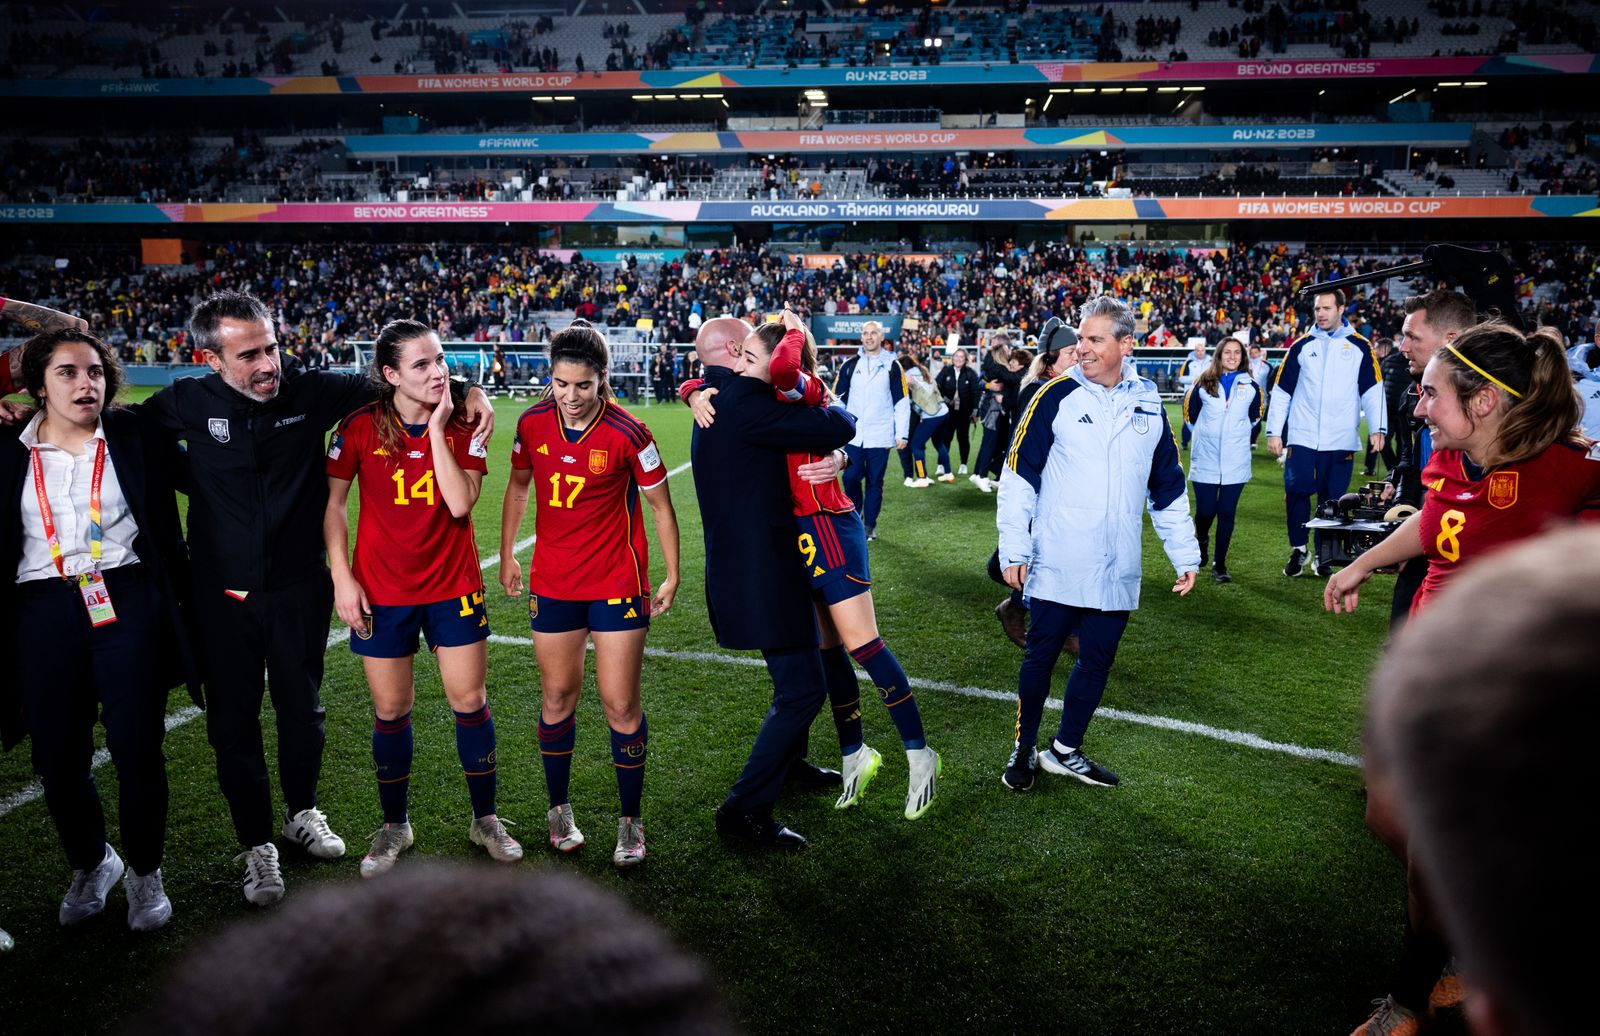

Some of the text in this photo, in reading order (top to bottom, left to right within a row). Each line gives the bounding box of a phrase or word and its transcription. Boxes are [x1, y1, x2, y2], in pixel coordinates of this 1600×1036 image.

[1237, 63, 1292, 75] BEYOND
[417, 76, 573, 88] FIFA WOMEN'S WORLD CUP
[479, 138, 539, 148] #FIFAWWC
[799, 133, 956, 145] FIFA WOMEN'S WORLD CUP
[353, 206, 407, 218] BEYOND
[750, 202, 980, 216] AUCKLAND TĀMAKI MAKAURAU
[1238, 201, 1441, 214] FIFA WOMEN'S WORLD CUP
[391, 468, 435, 506] 14
[549, 472, 586, 509] 17
[1436, 509, 1467, 563] 8
[797, 532, 817, 567] 9
